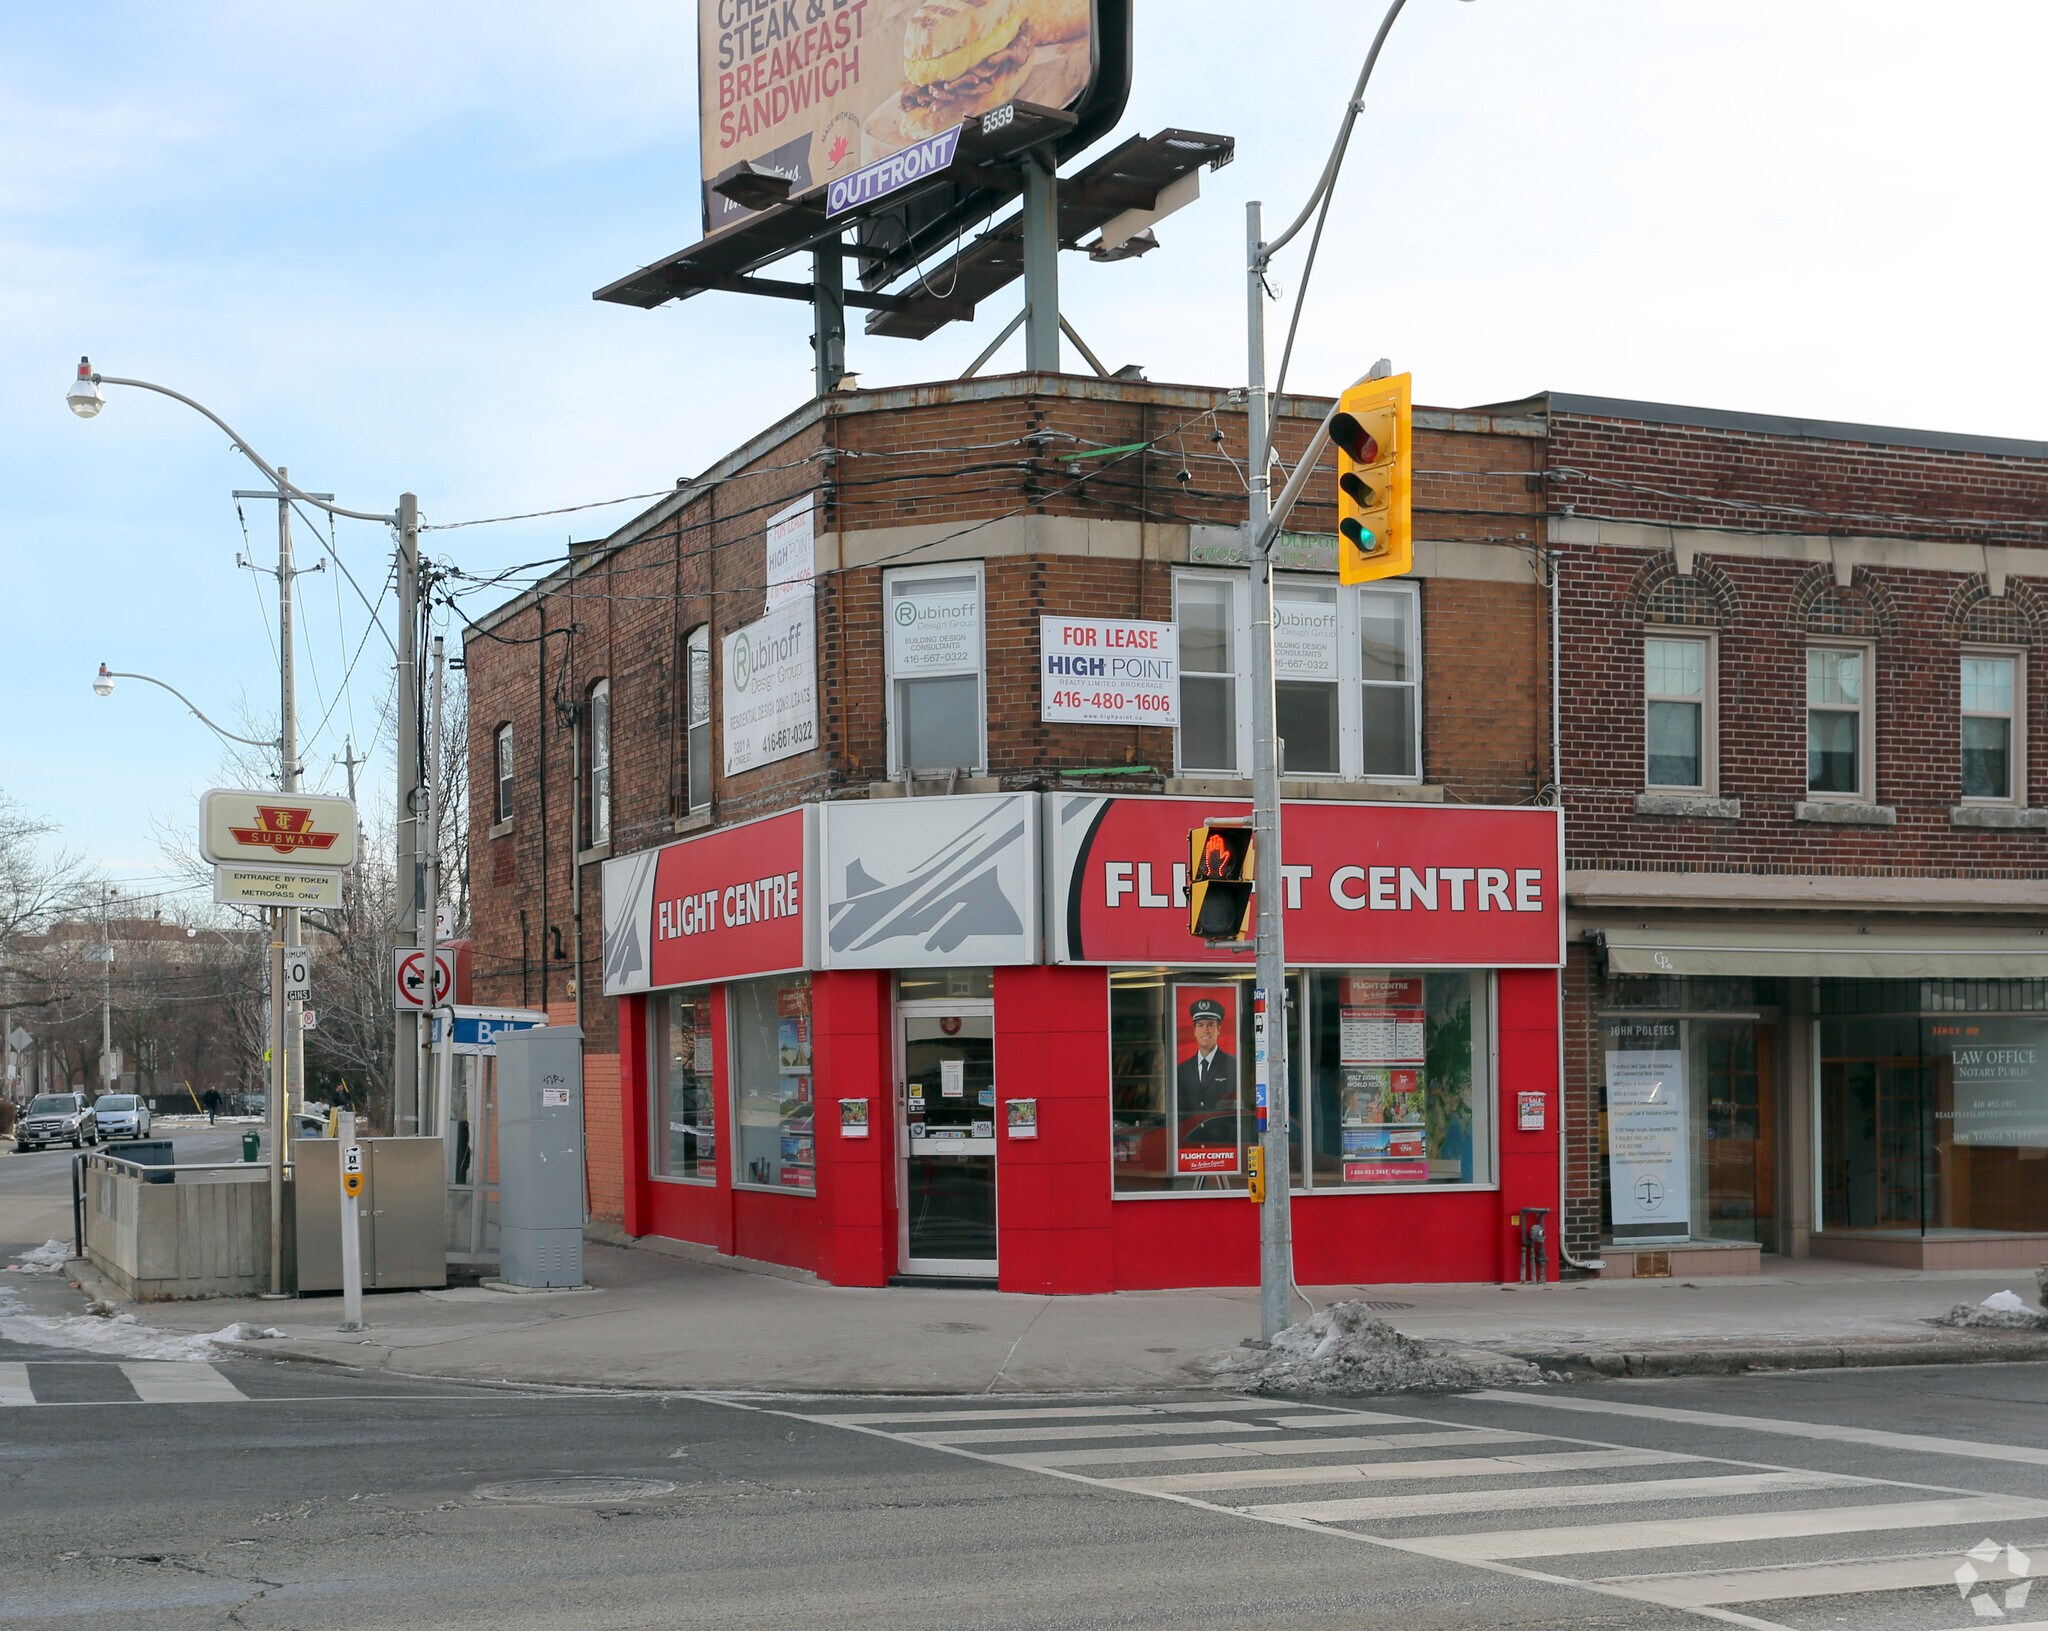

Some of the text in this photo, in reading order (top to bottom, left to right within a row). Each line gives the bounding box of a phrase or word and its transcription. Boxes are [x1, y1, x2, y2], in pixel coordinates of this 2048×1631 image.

[719, 0, 800, 70] STEAK
[720, 0, 868, 110] BREAKFAST
[720, 45, 860, 149] SANDWICH
[982, 104, 1014, 134] 5559
[831, 132, 954, 211] OUTFRONT
[768, 545, 788, 572] HIGH
[789, 532, 812, 561] POINT
[897, 602, 976, 623] Rubinoff
[917, 619, 977, 631] Design Group
[1281, 628, 1310, 638] Design
[904, 634, 967, 645] BUILDING DESIGN
[1063, 627, 1158, 649] FOR LEASE
[1274, 641, 1328, 651] UILDING DESIGN
[735, 622, 802, 682] Rubinoff
[910, 642, 961, 652] CONSULTANTS
[1275, 648, 1322, 658] CONSULTANTS
[903, 651, 968, 664] 416-667-0322
[1275, 659, 1329, 670] 16-667-0322
[1048, 655, 1173, 679] HIGH POINT
[751, 662, 803, 695] Design Group
[1060, 678, 1085, 687] REALTY
[1120, 682, 1163, 690] BROKERAGE
[758, 702, 775, 722] DESIGN
[775, 688, 811, 715] CONSULTANTS
[1053, 691, 1170, 712] 416-480-1606
[762, 720, 813, 754] 416-667-0322
[251, 832, 317, 845] SUBWAY
[234, 873, 280, 883] ENTRANCE
[284, 875, 296, 883] BY
[241, 889, 320, 900] METROPASS ONLY
[1105, 861, 1543, 912] FLIT CENTRE
[658, 871, 798, 941] FLIGHT CENTRE
[1380, 982, 1408, 990] CENTRE
[288, 990, 308, 1000] GINS
[1610, 1025, 1675, 1037] JOHN POLETES
[1952, 1049, 2037, 1065] LAW OFFICE
[1973, 1101, 1985, 1109] 416
